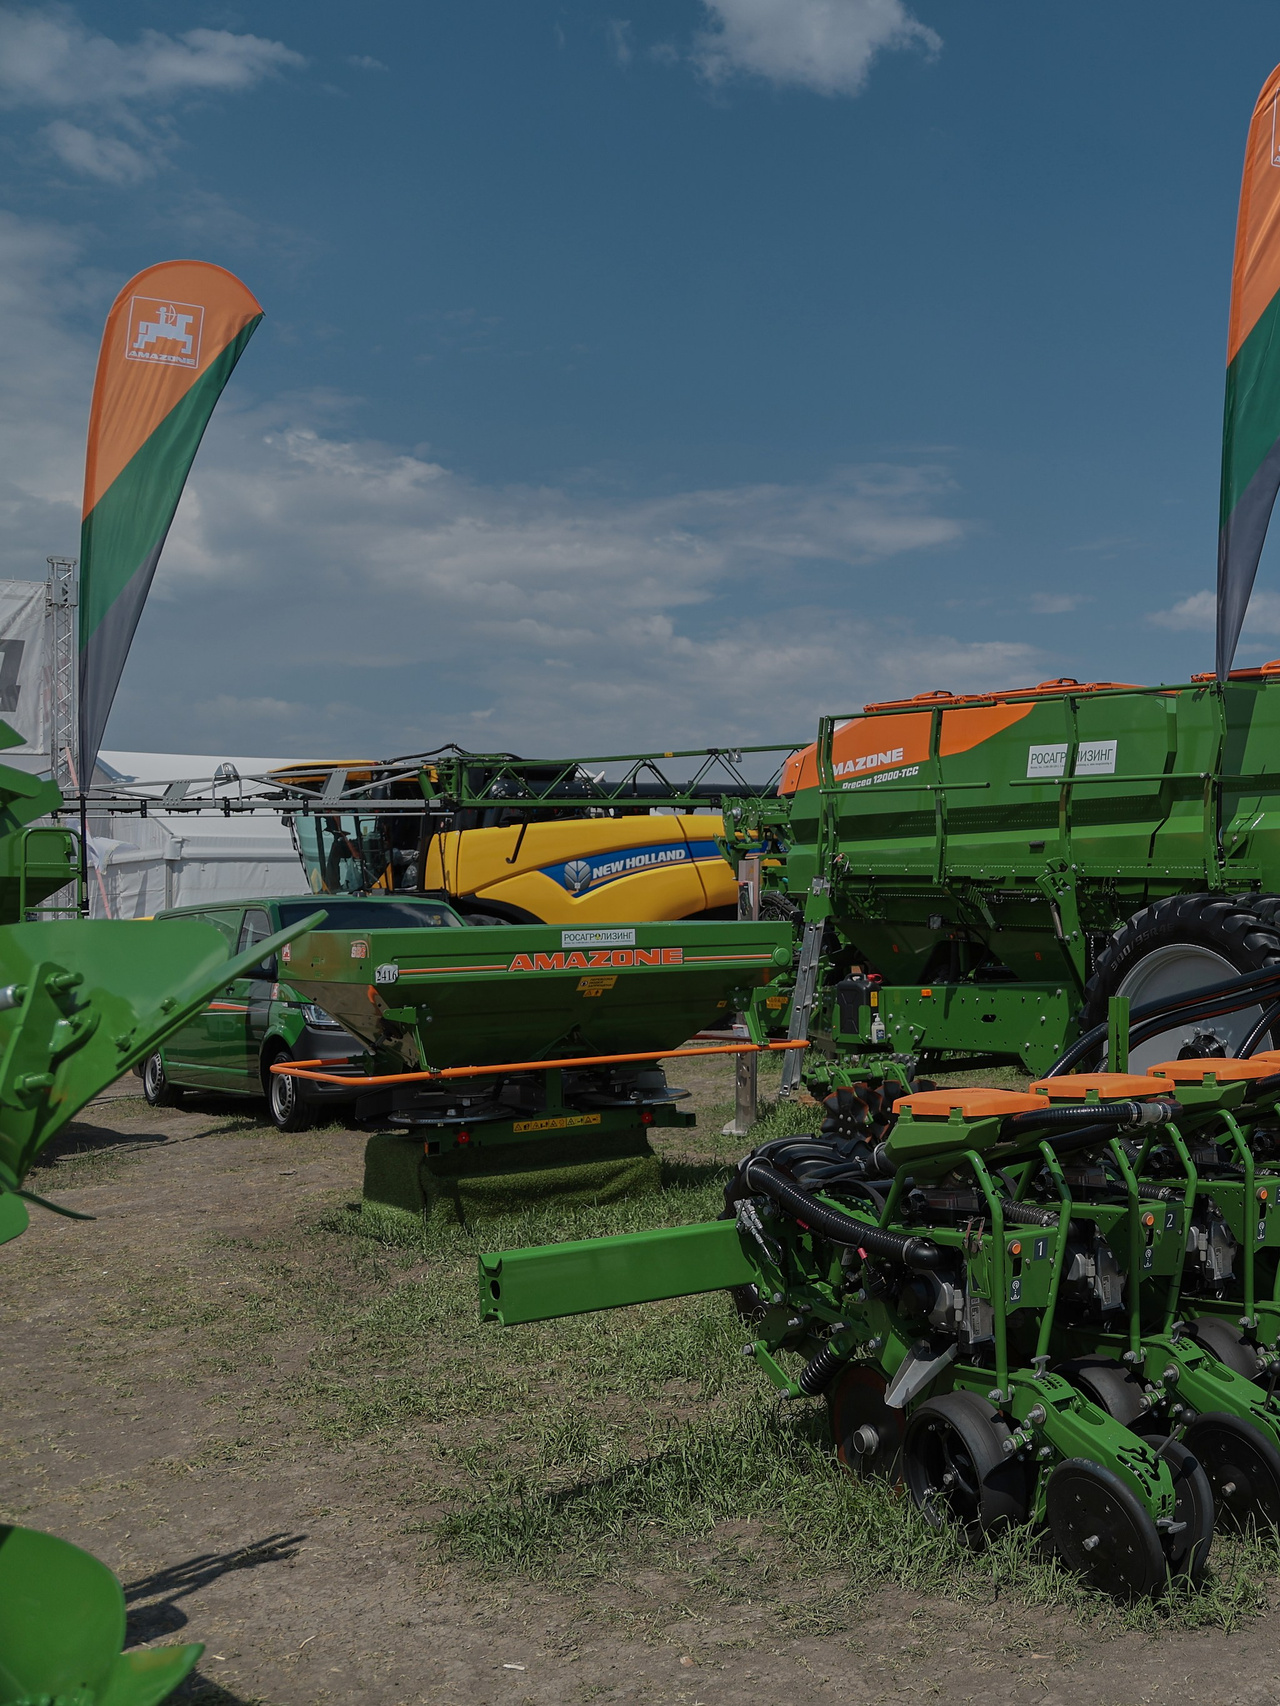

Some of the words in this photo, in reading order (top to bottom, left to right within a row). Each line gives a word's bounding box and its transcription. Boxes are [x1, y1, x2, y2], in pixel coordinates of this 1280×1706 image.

[128, 350, 196, 366] AMAZONE
[832, 747, 904, 776] MAZONE
[873, 765, 919, 783] 12000-TCC
[592, 859, 625, 879] NEW
[625, 849, 686, 869] HOLLAND
[507, 947, 684, 972] AMAZONE
[376, 968, 398, 982] 2416
[1165, 1213, 1174, 1229] 2
[1037, 1240, 1044, 1257] 1
